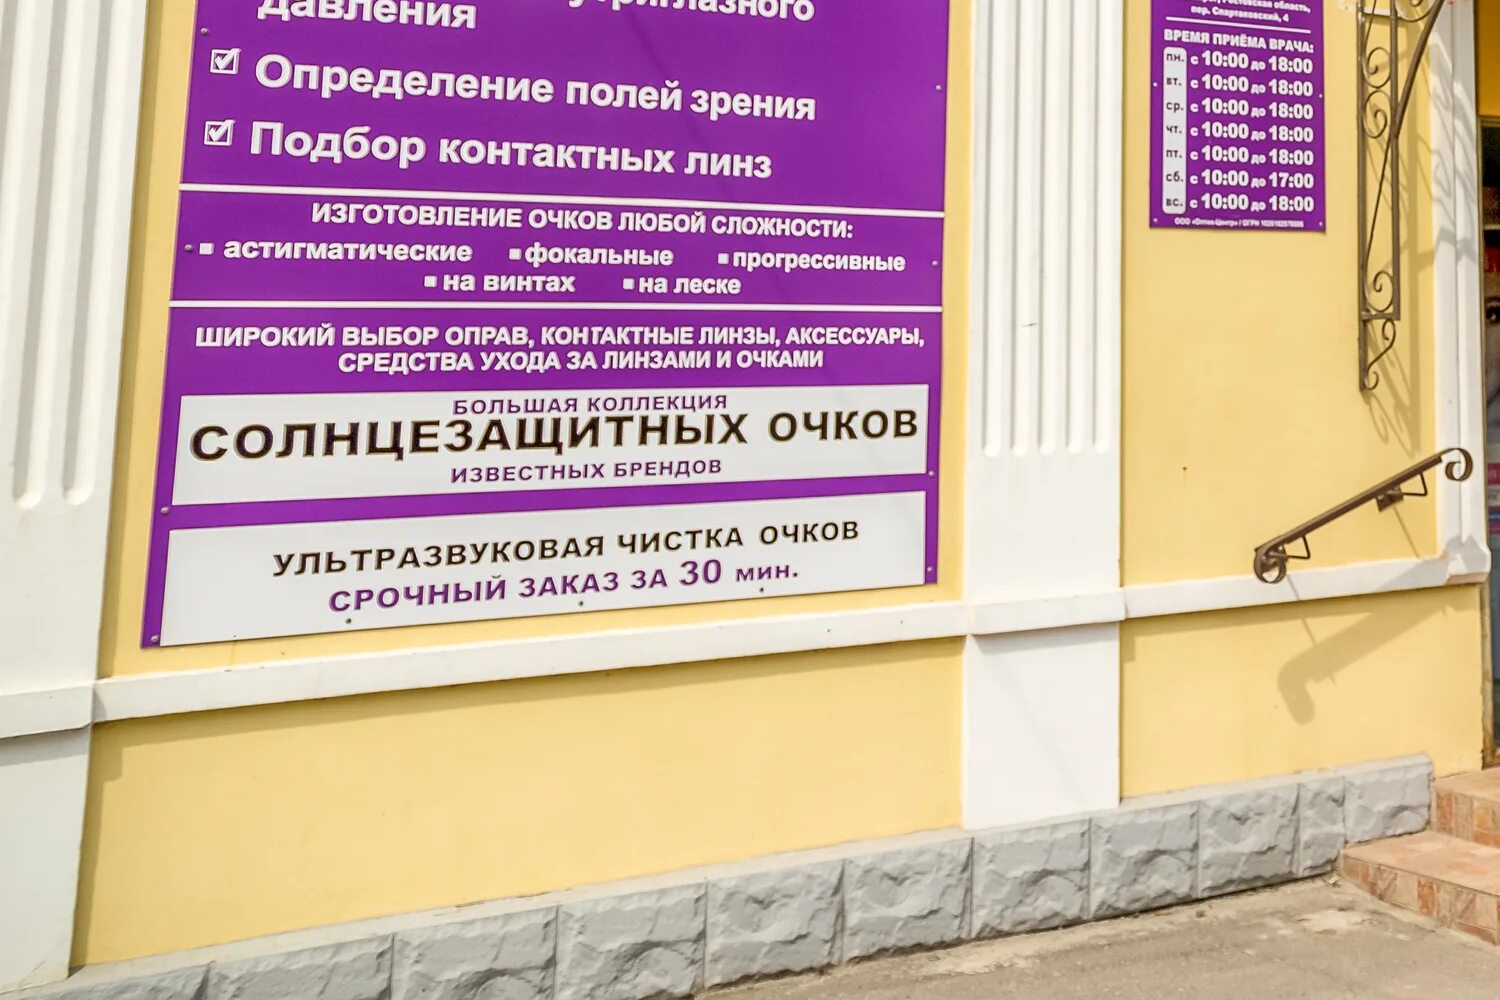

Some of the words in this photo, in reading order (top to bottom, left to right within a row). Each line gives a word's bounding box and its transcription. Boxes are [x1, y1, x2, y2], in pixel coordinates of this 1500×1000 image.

[1164, 29, 1209, 44] ВРЕМЯ
[1213, 31, 1267, 49] ПРИЁМА
[1269, 39, 1314, 53] ВРАЧА:
[1166, 54, 1185, 63] пн.
[1190, 56, 1199, 65] с
[1201, 50, 1249, 69] 10:00
[1251, 61, 1266, 71] до
[1268, 55, 1314, 73] 18:00
[254, 54, 554, 105] Определение
[565, 76, 683, 113] полей
[690, 89, 816, 123] зрения
[1166, 76, 1182, 87] вт.
[1190, 80, 1199, 89] с
[1201, 75, 1249, 93] 10:00
[1251, 85, 1266, 95] до
[1268, 79, 1314, 97] 18:00
[1166, 102, 1184, 113] ср.
[1190, 104, 1199, 113] с
[1201, 99, 1249, 116] 10:00
[1251, 109, 1266, 119] до
[1268, 103, 1314, 120] 18:00
[1166, 125, 1183, 135] чт.
[1190, 128, 1199, 137] с
[1201, 123, 1249, 140] 10:00
[1251, 131, 1266, 142] до
[1268, 126, 1314, 143] 18:00
[249, 121, 426, 167] Подбор
[438, 138, 674, 176] контактных
[684, 149, 773, 179] линз
[1166, 150, 1183, 160] пт.
[1190, 152, 1199, 161] с
[1201, 146, 1249, 163] 10:00
[1251, 155, 1266, 165] до
[1268, 149, 1314, 166] 18:00
[1166, 172, 1184, 183] сб.
[1190, 176, 1199, 184] с
[1201, 170, 1249, 187] 10:00
[1251, 178, 1266, 189] до
[1268, 172, 1314, 189] 17:00
[1166, 198, 1184, 208] вс.
[1190, 200, 1199, 209] с
[1201, 193, 1249, 211] 10:00
[1251, 202, 1266, 212] до
[1268, 195, 1314, 213] 18:00
[311, 203, 523, 232] ИЗГОТОВЛЕНИЕ
[528, 207, 613, 232] ОЧКОВ
[617, 208, 706, 235] ЛЮБОЙ
[711, 212, 853, 240] СЛОЖНОСТИ:
[223, 239, 473, 264] астигматические
[524, 242, 674, 271] фокальные
[732, 248, 906, 274] прогрессивные
[442, 271, 476, 293] на
[483, 271, 576, 294] винтах
[638, 274, 667, 295] на
[673, 274, 742, 296] леске
[194, 321, 335, 349] ШИРОКИЙ
[341, 325, 438, 347] ВЫБОР
[443, 325, 535, 349] ОПРАВ,
[540, 325, 694, 347] КОНТАКТНЫЕ
[698, 325, 780, 349] ЛИНЗЫ,
[785, 324, 925, 349] АКСЕССУАРЫ,
[337, 352, 475, 376] СРЕДСТВА
[479, 352, 561, 373] УХОДА
[566, 351, 597, 372] ЗА
[601, 350, 710, 372] ЛИНЗАМИ
[716, 351, 731, 370] И
[736, 349, 824, 370] ОЧКАМИ
[452, 397, 580, 416] БОЛЬШАЯ
[587, 393, 728, 413] КОЛЛЕКЦИЯ
[189, 411, 749, 463] СОЛНЦЕЗАЩИТНЫХ
[767, 408, 919, 442] ОЧКОВ
[450, 463, 606, 484] ИЗВЕСТНЫХ
[613, 458, 722, 480] БРЕНДОВ
[272, 533, 605, 577] УЛЬТРАЗВУКОВАЯ
[616, 527, 744, 554] ЧИСТКА
[758, 519, 860, 546] ОЧКОВ
[328, 574, 508, 613] СРОЧНЫЙ
[518, 570, 621, 598] ЗАКАЗ
[630, 567, 672, 590] ЗА
[678, 558, 722, 587] 30
[734, 565, 799, 584] мин.
